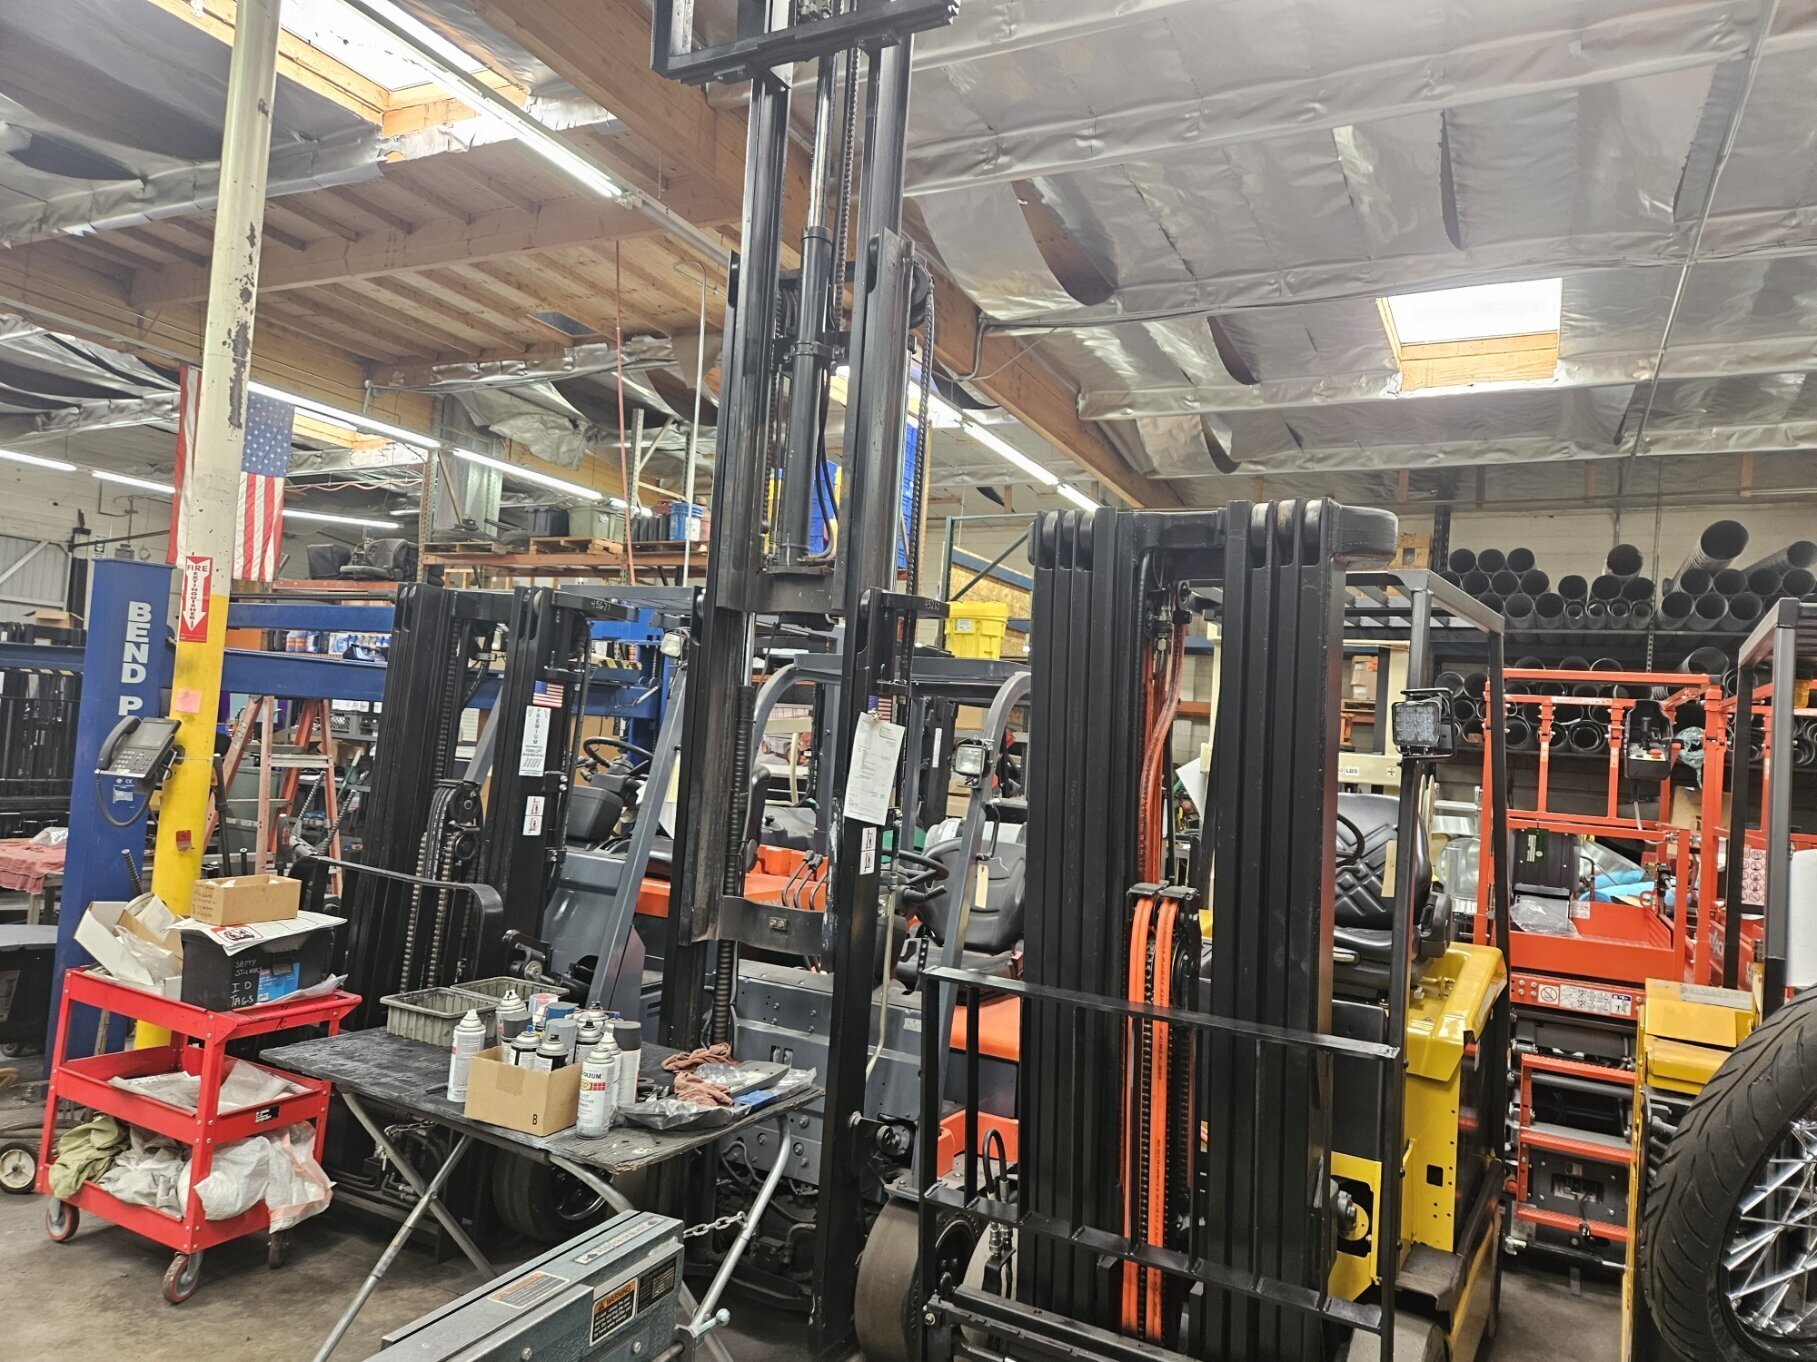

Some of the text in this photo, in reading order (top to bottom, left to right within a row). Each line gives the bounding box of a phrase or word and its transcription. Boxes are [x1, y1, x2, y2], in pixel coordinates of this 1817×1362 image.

[187, 564, 208, 572] FIRE
[118, 600, 152, 717] BEND P
[532, 708, 541, 744] PREMIUM
[230, 995, 254, 1008] TAGS
[583, 1071, 602, 1079] OLEUM
[532, 1114, 538, 1125] B
